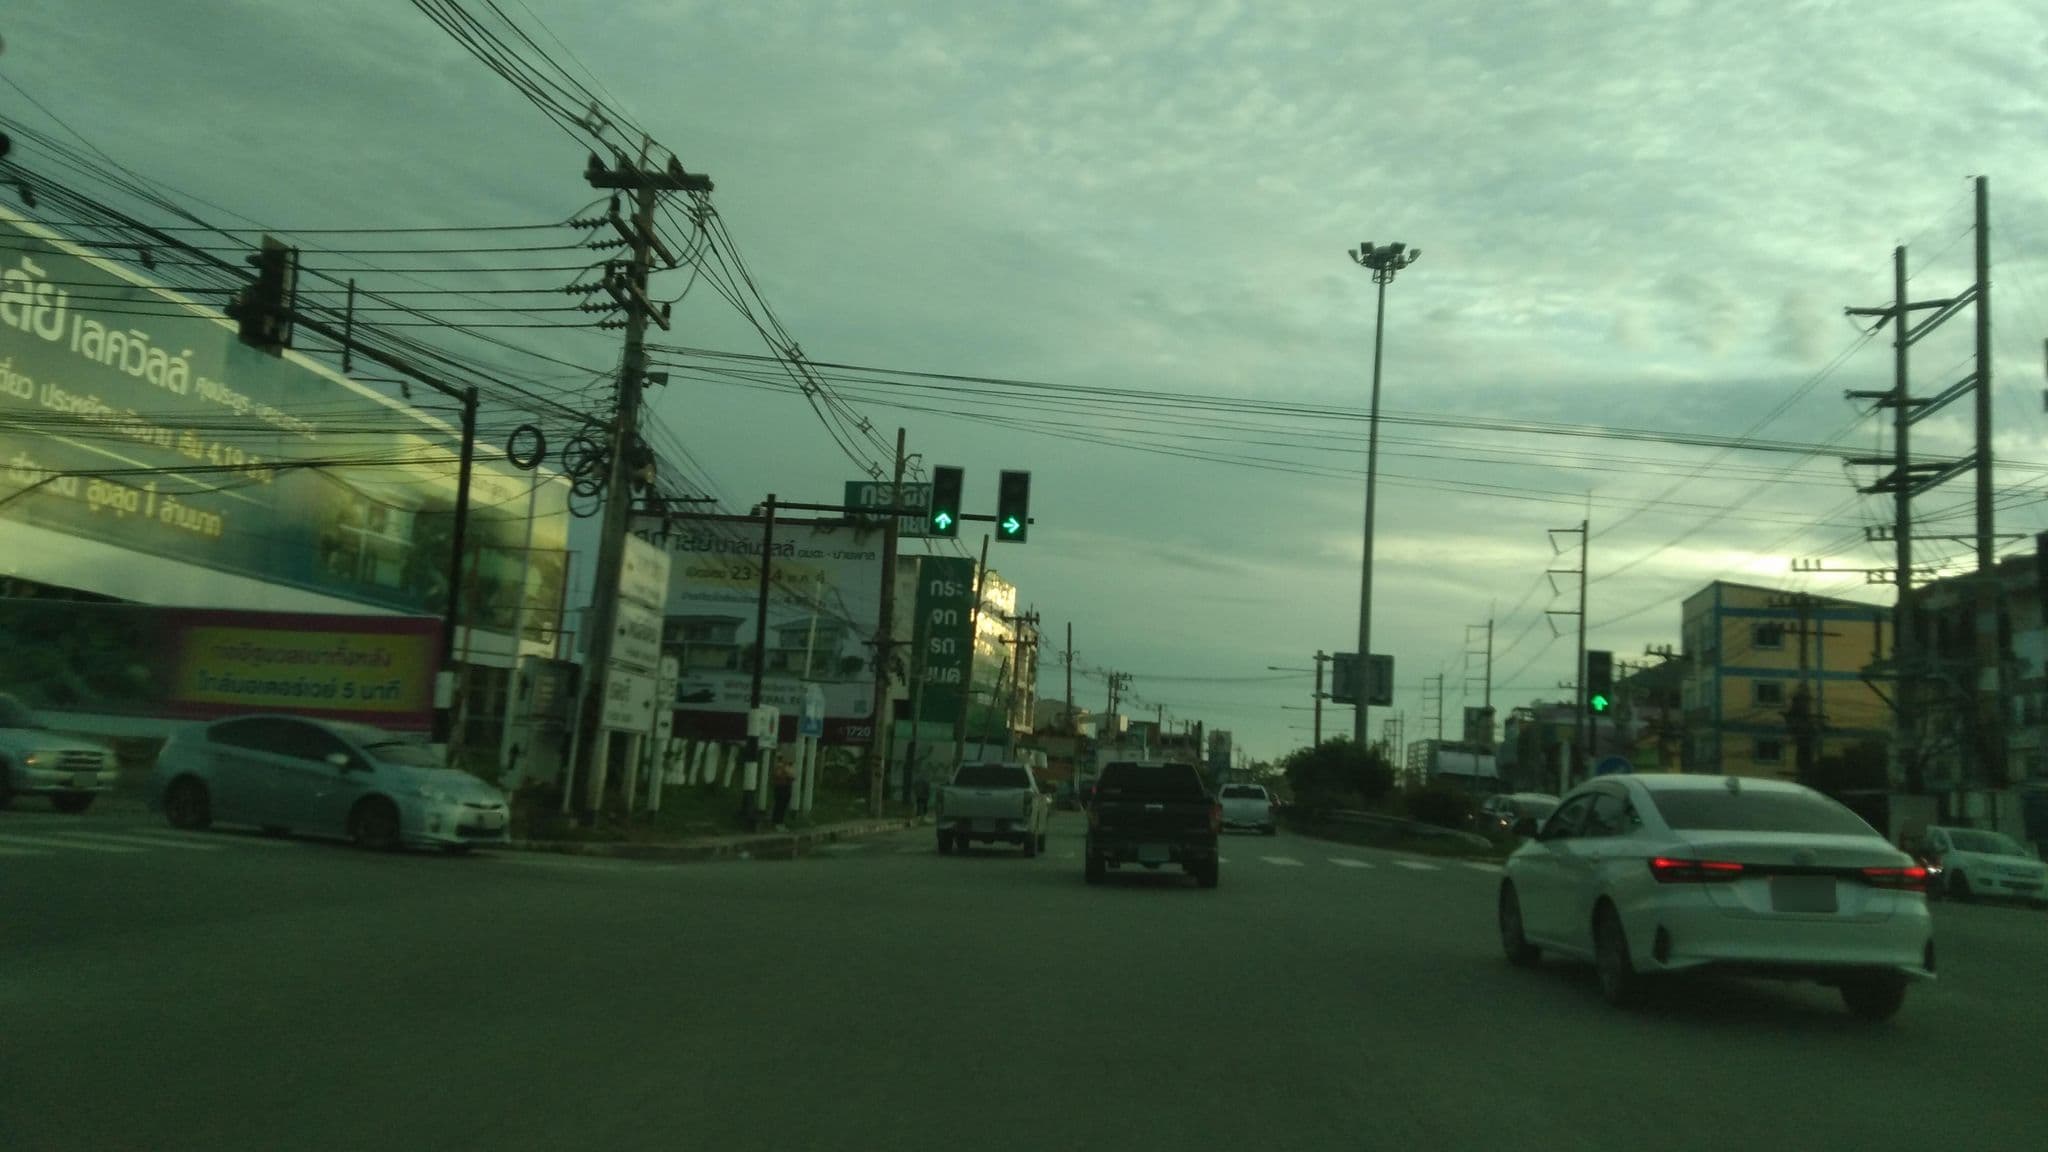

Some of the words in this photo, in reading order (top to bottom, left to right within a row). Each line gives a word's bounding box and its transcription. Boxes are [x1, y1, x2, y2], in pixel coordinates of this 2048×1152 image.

[71, 315, 193, 395] เลควิลล์
[930, 579, 964, 597] กระ
[932, 608, 958, 626] จก
